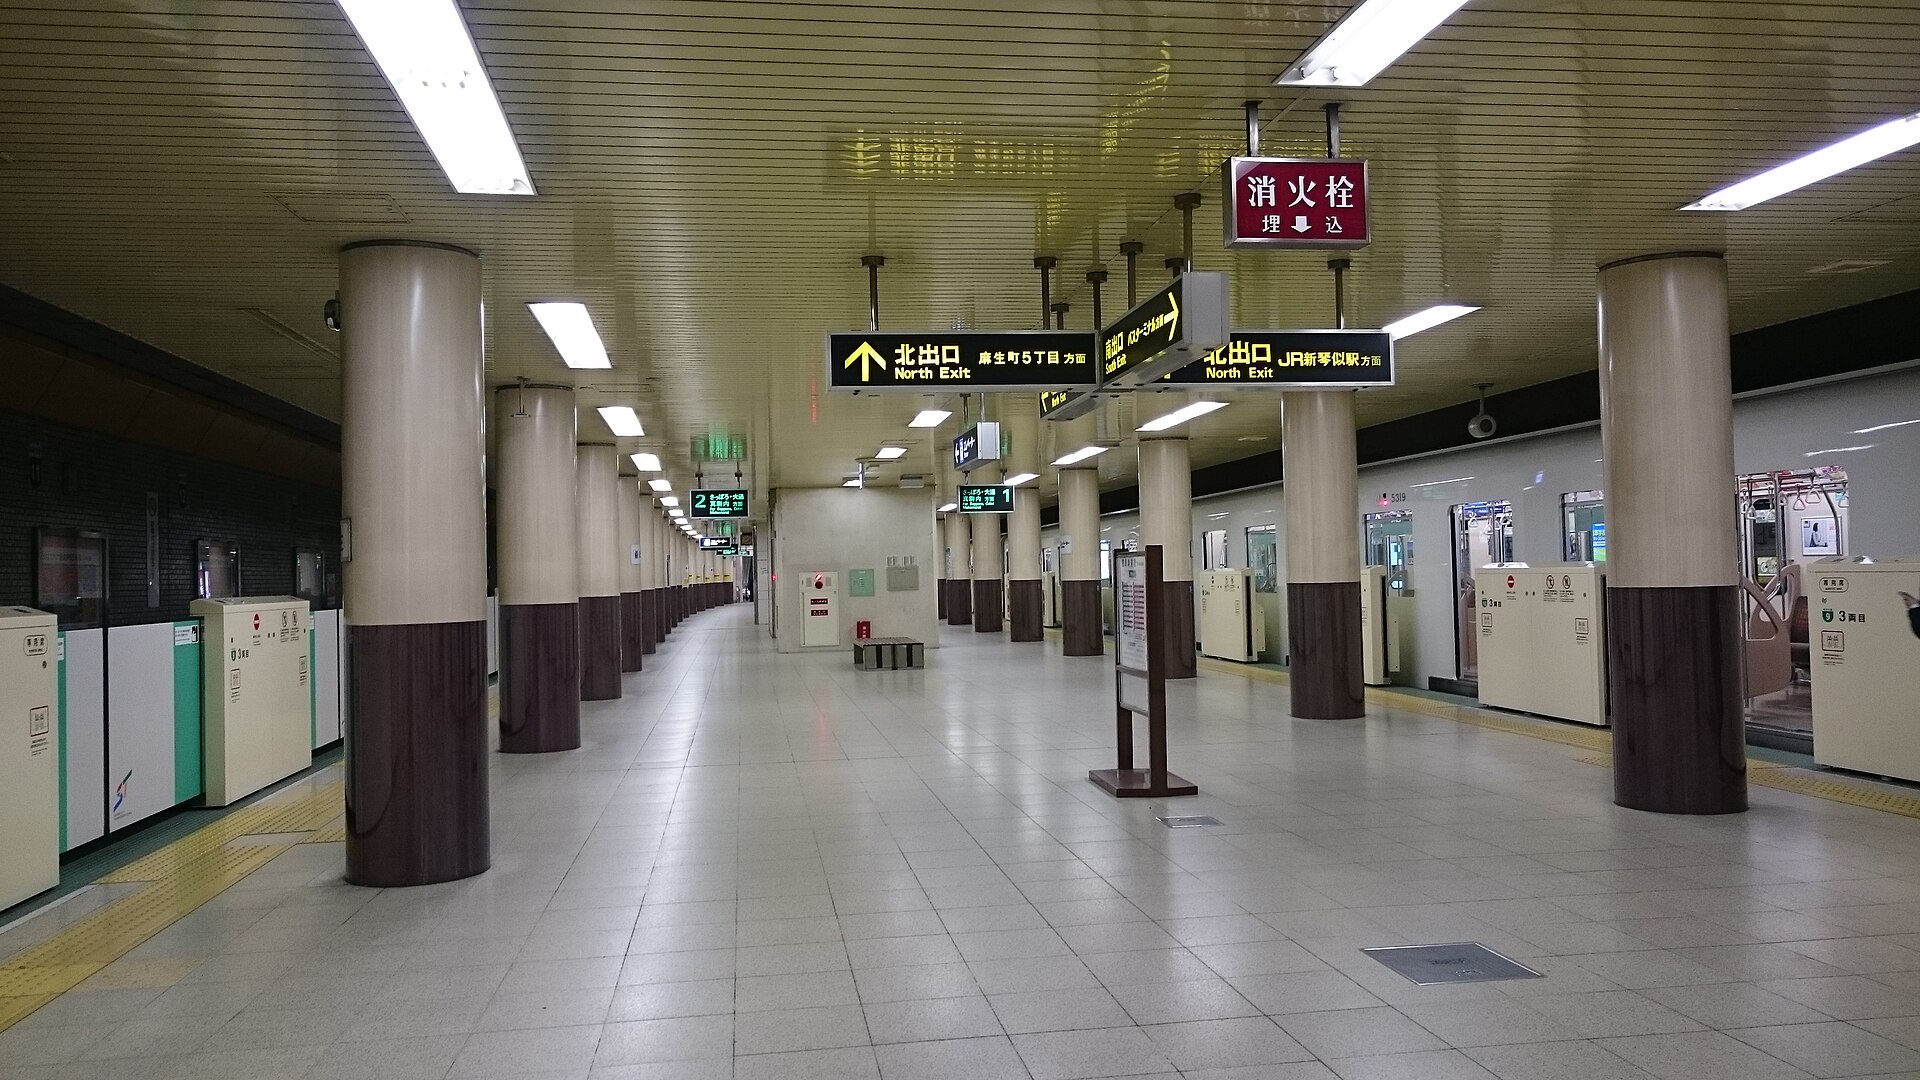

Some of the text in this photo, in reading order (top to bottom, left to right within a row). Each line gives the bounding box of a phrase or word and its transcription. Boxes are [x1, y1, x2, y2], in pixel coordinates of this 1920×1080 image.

[1247, 175, 1354, 208] 消火栓
[895, 343, 960, 366] 北出口
[894, 366, 971, 380] North Exit
[1206, 367, 1274, 379] North Exit
[694, 494, 706, 509] 2
[1002, 488, 1010, 503] 1
